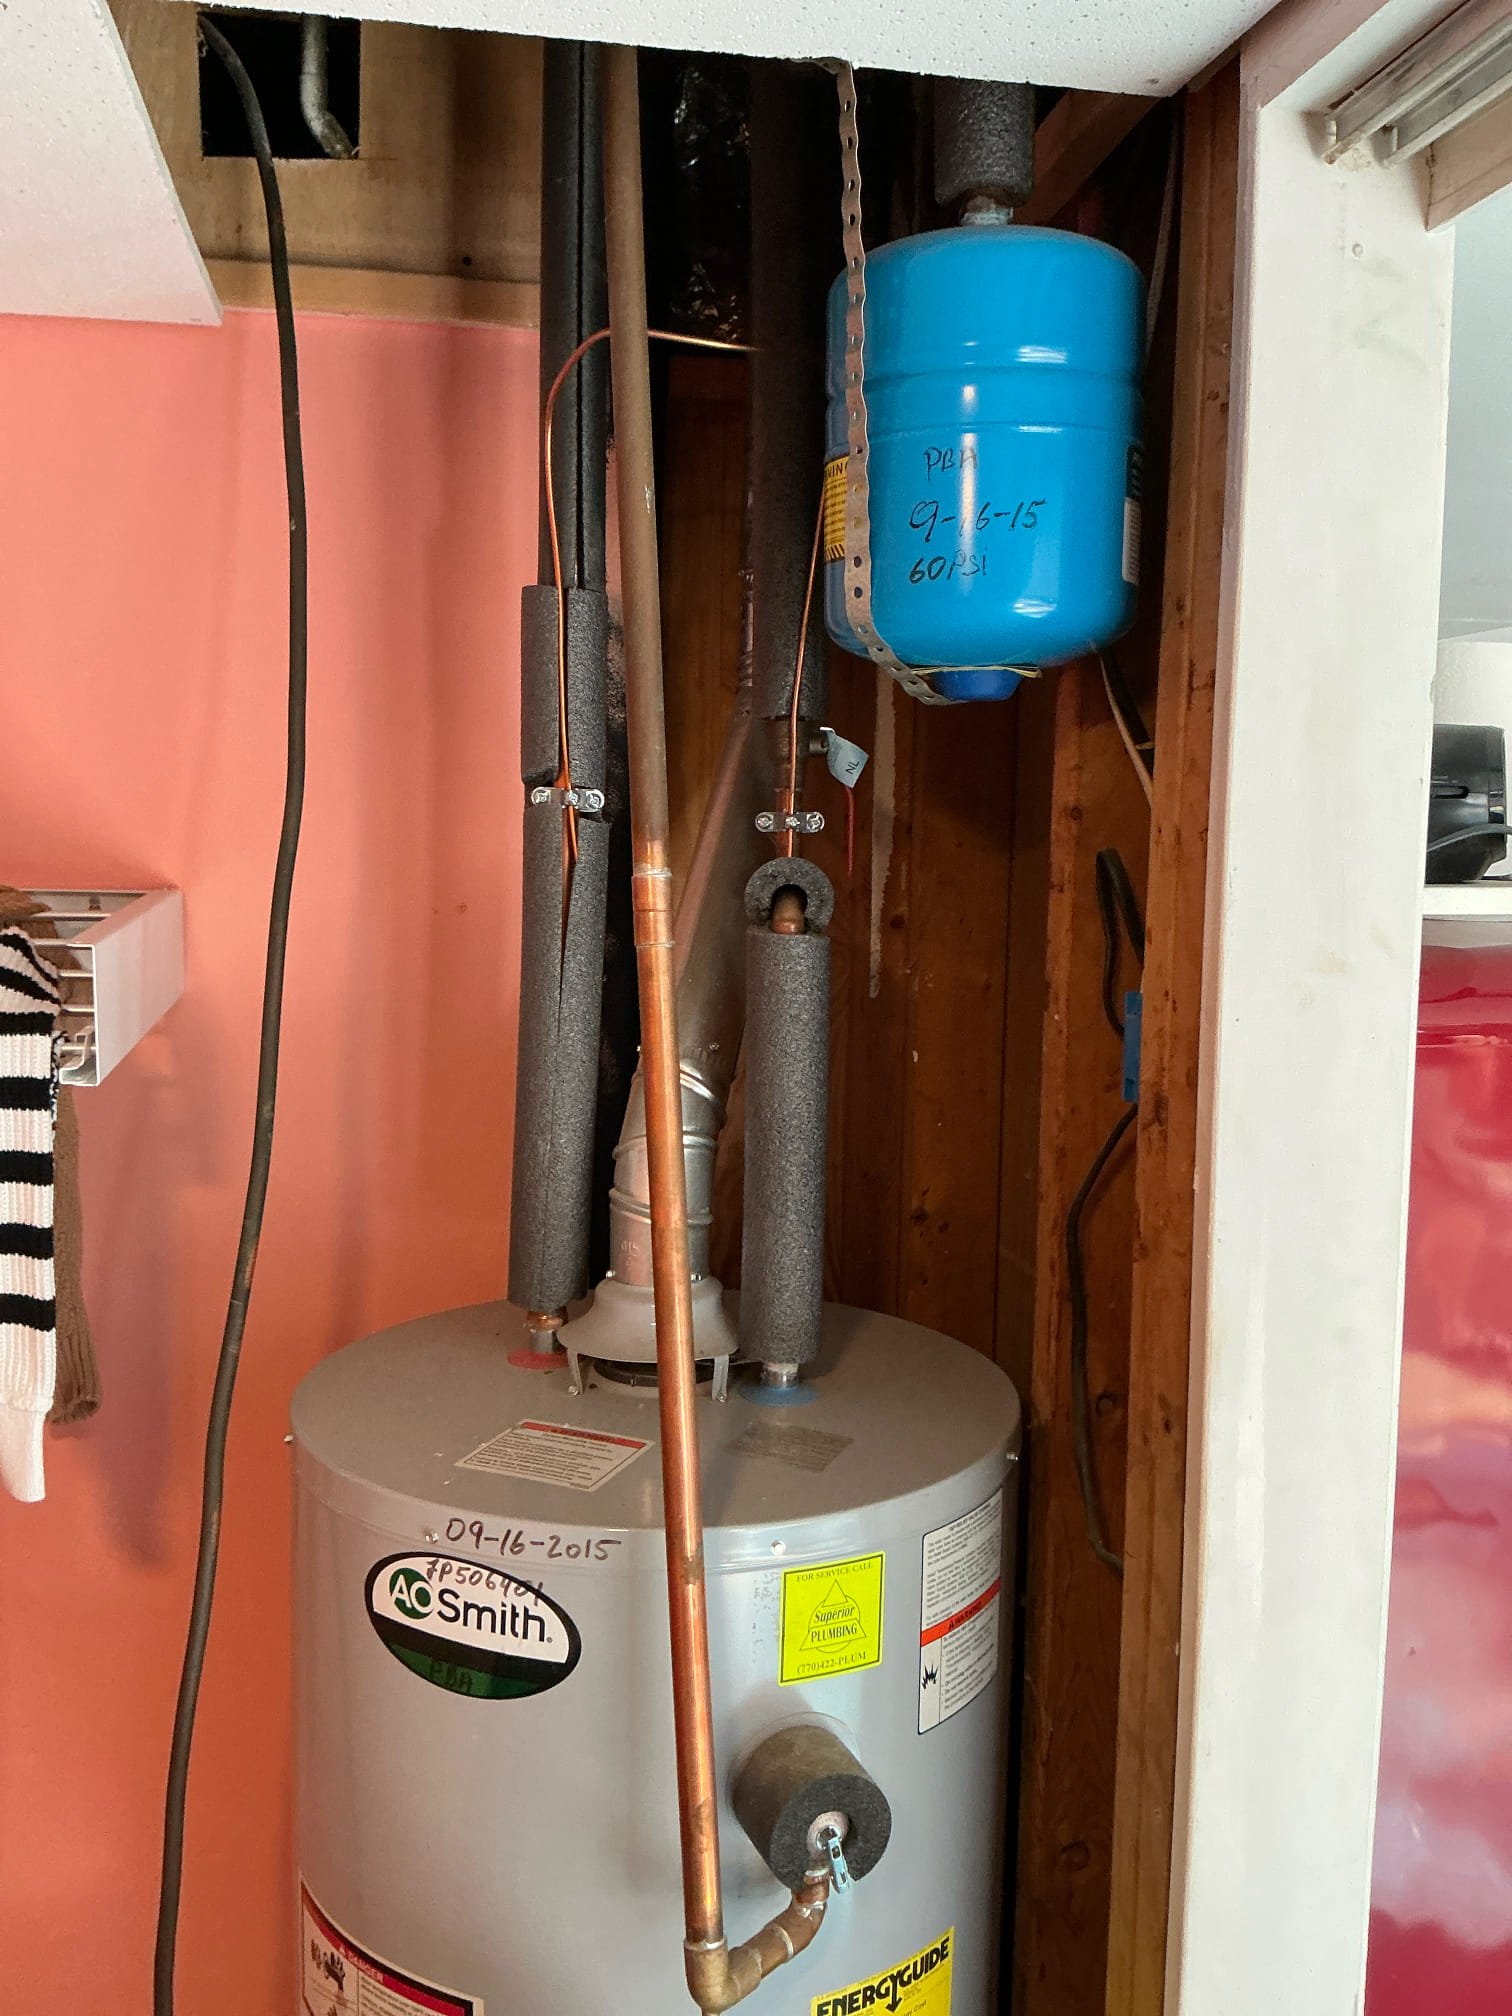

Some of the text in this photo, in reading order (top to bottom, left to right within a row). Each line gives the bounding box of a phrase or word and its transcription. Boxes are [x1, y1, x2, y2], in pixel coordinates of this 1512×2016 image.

[924, 446, 978, 481] PBA
[446, 1517, 621, 1560] 09-16-2015
[796, 1561, 873, 1583] FOR SERVICE CALL
[437, 1589, 546, 1642] Smith
[814, 1605, 855, 1625] Superior
[811, 1623, 857, 1643] PLUMBING
[796, 1651, 867, 1675] (770)422-PLUM
[816, 1936, 950, 2016] ENERGYGUIDE
